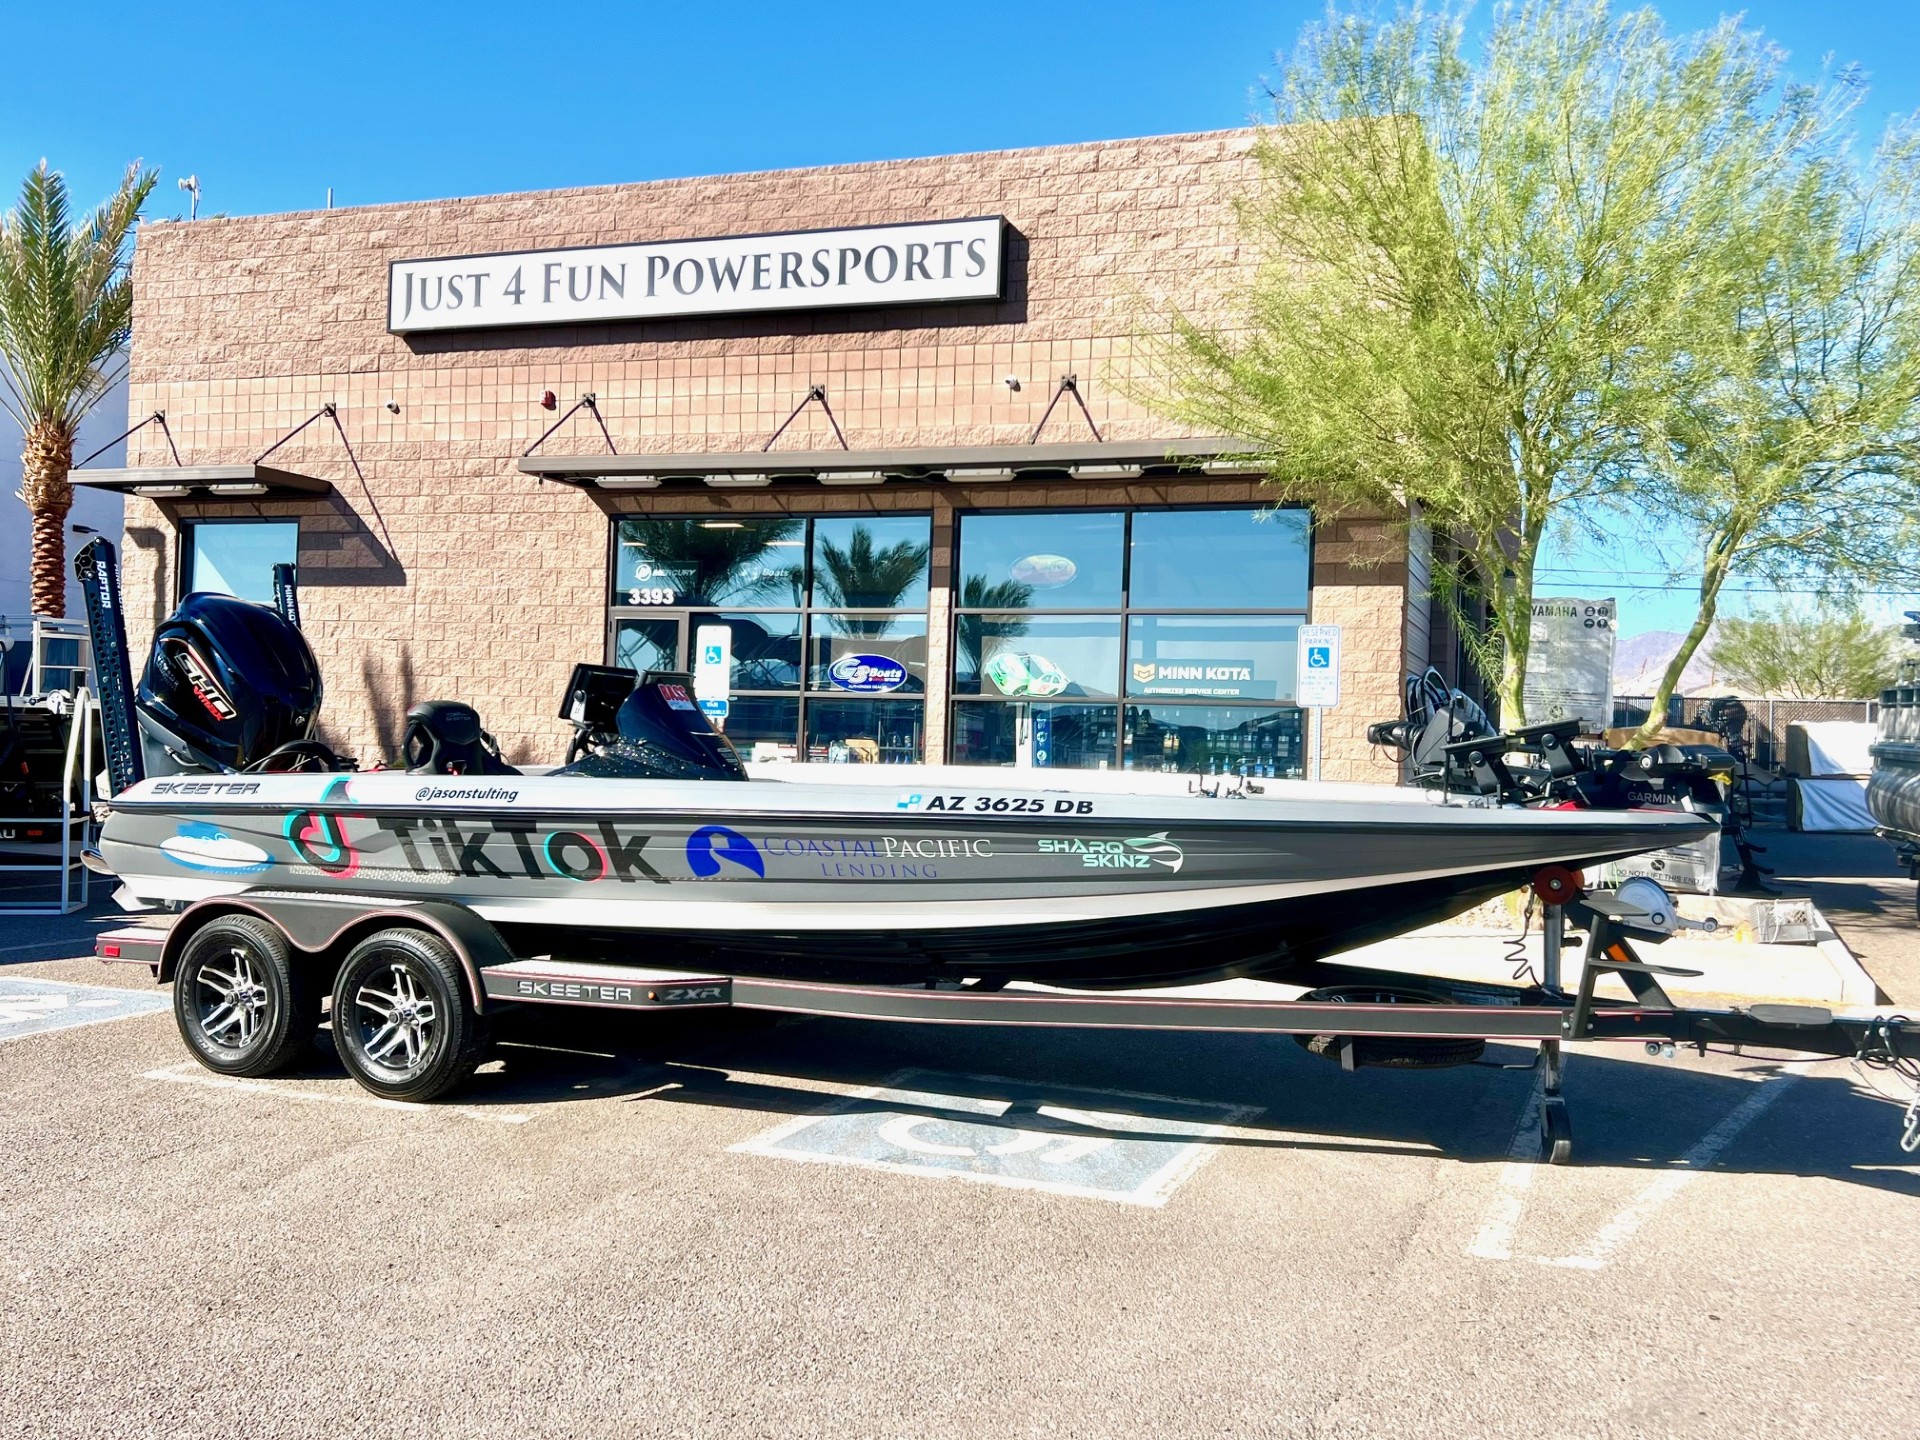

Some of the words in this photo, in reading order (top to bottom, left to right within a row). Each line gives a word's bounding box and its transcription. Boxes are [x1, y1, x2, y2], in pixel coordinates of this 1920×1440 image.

[402, 271, 490, 322] JUST
[502, 264, 526, 305] 4
[542, 261, 628, 303] FUN
[644, 238, 987, 298] POWERSPORTS
[652, 568, 696, 577] MERCURY
[96, 560, 111, 609] RAPTOR
[284, 584, 295, 608] MINN
[628, 588, 674, 605] 3393
[287, 608, 297, 627] KO
[1531, 605, 1577, 617] YAMAHA
[1302, 628, 1337, 637] RESERVED
[1304, 638, 1334, 646] PARKING
[833, 658, 871, 685] G3
[869, 668, 902, 678] Boats
[1158, 666, 1203, 680] MINN
[1205, 667, 1251, 681] KOTA
[658, 684, 690, 702] BASS
[1143, 687, 1184, 695] AUTHORIZED
[1184, 687, 1213, 695] SERVICE
[1213, 687, 1240, 696] CENTER
[150, 782, 261, 795] SKEETER
[415, 786, 520, 803] @jasonstulting
[925, 796, 967, 811] AZ
[974, 797, 1045, 813] 3625
[1053, 800, 1094, 814] DB
[1627, 791, 1676, 804] GARMIN
[375, 816, 673, 885] TikTok
[1037, 838, 1124, 854] SHARQ
[1082, 854, 1150, 868] SKINZ
[821, 863, 937, 878] LENDING
[1665, 874, 1681, 882] THIS
[517, 981, 632, 1001] SKEETER
[665, 987, 723, 1000] ZXR
